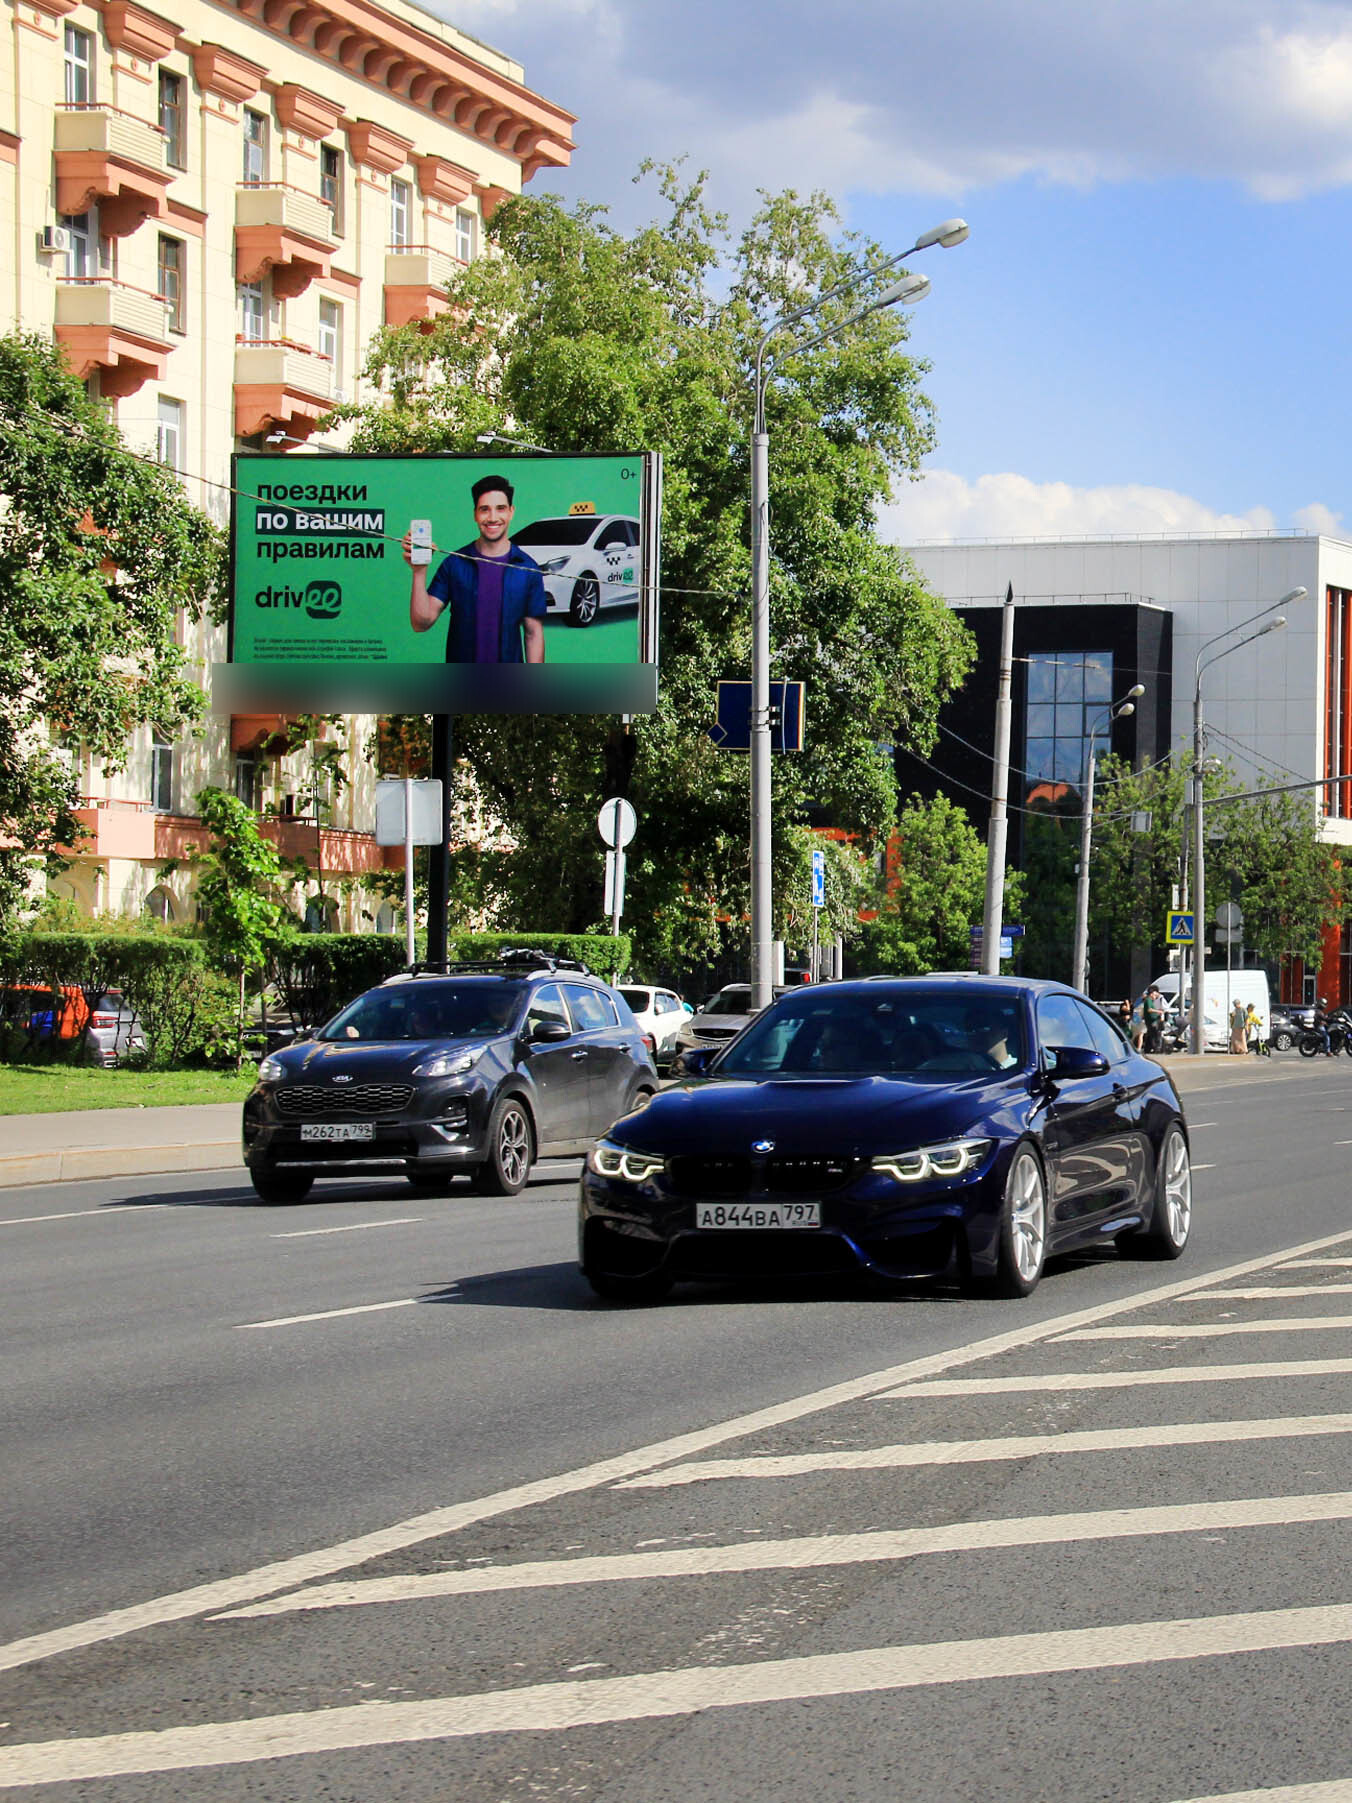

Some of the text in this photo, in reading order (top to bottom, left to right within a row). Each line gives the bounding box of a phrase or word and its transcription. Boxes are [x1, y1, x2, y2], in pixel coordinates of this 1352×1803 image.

[621, 468, 637, 480] 0+
[257, 484, 368, 505] поездки
[256, 512, 383, 530] по вашим
[256, 541, 385, 563] правилам
[254, 581, 342, 615] drivee
